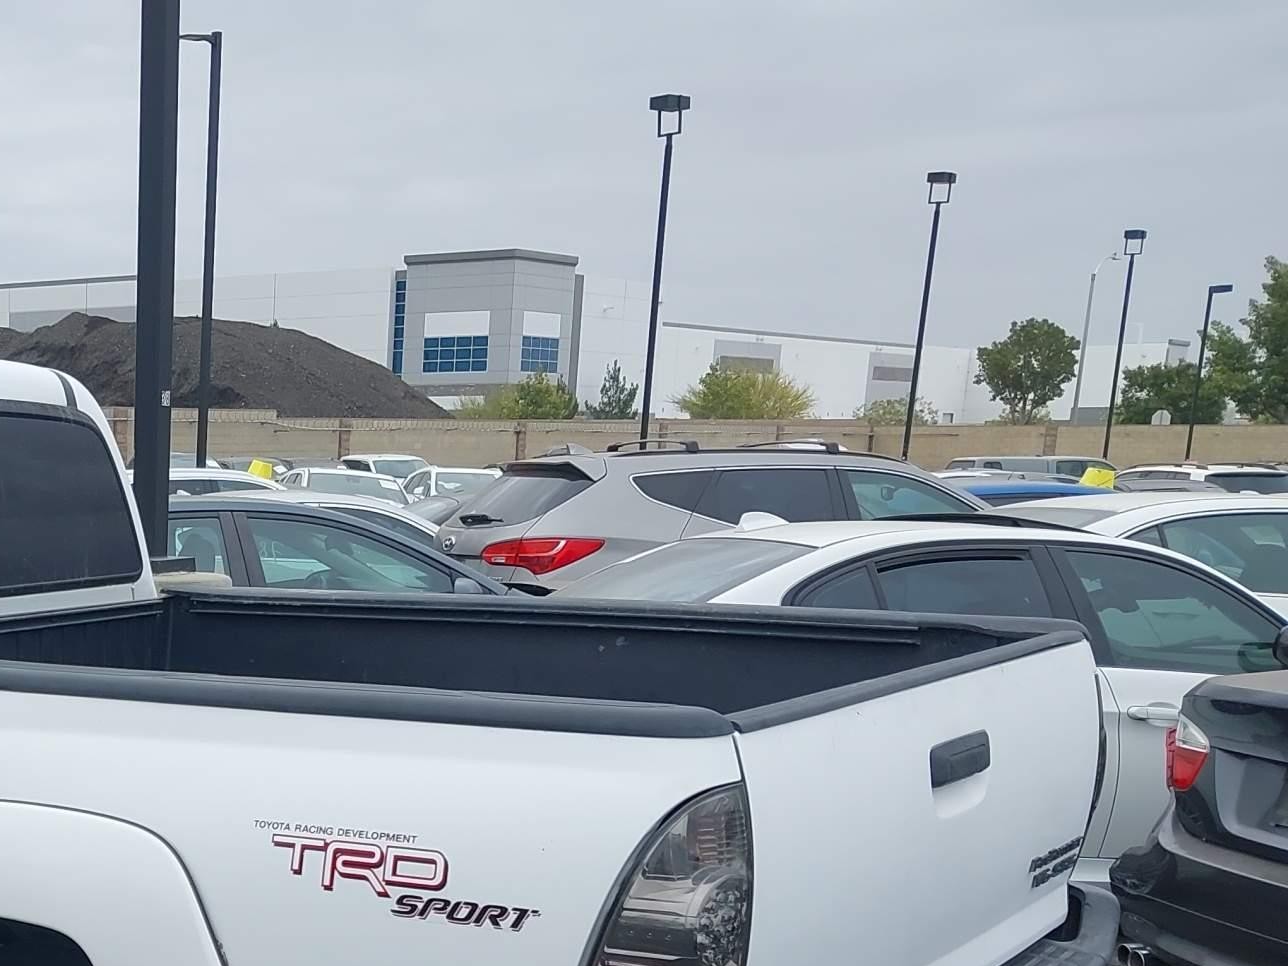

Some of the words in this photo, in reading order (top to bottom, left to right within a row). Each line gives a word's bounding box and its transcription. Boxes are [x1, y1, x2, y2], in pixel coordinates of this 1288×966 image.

[253, 819, 291, 833] TOYOTA
[294, 823, 334, 837] RACING
[337, 827, 418, 845] DEVELOPMENT
[272, 833, 449, 899] TRD
[391, 894, 541, 932] SPORT
